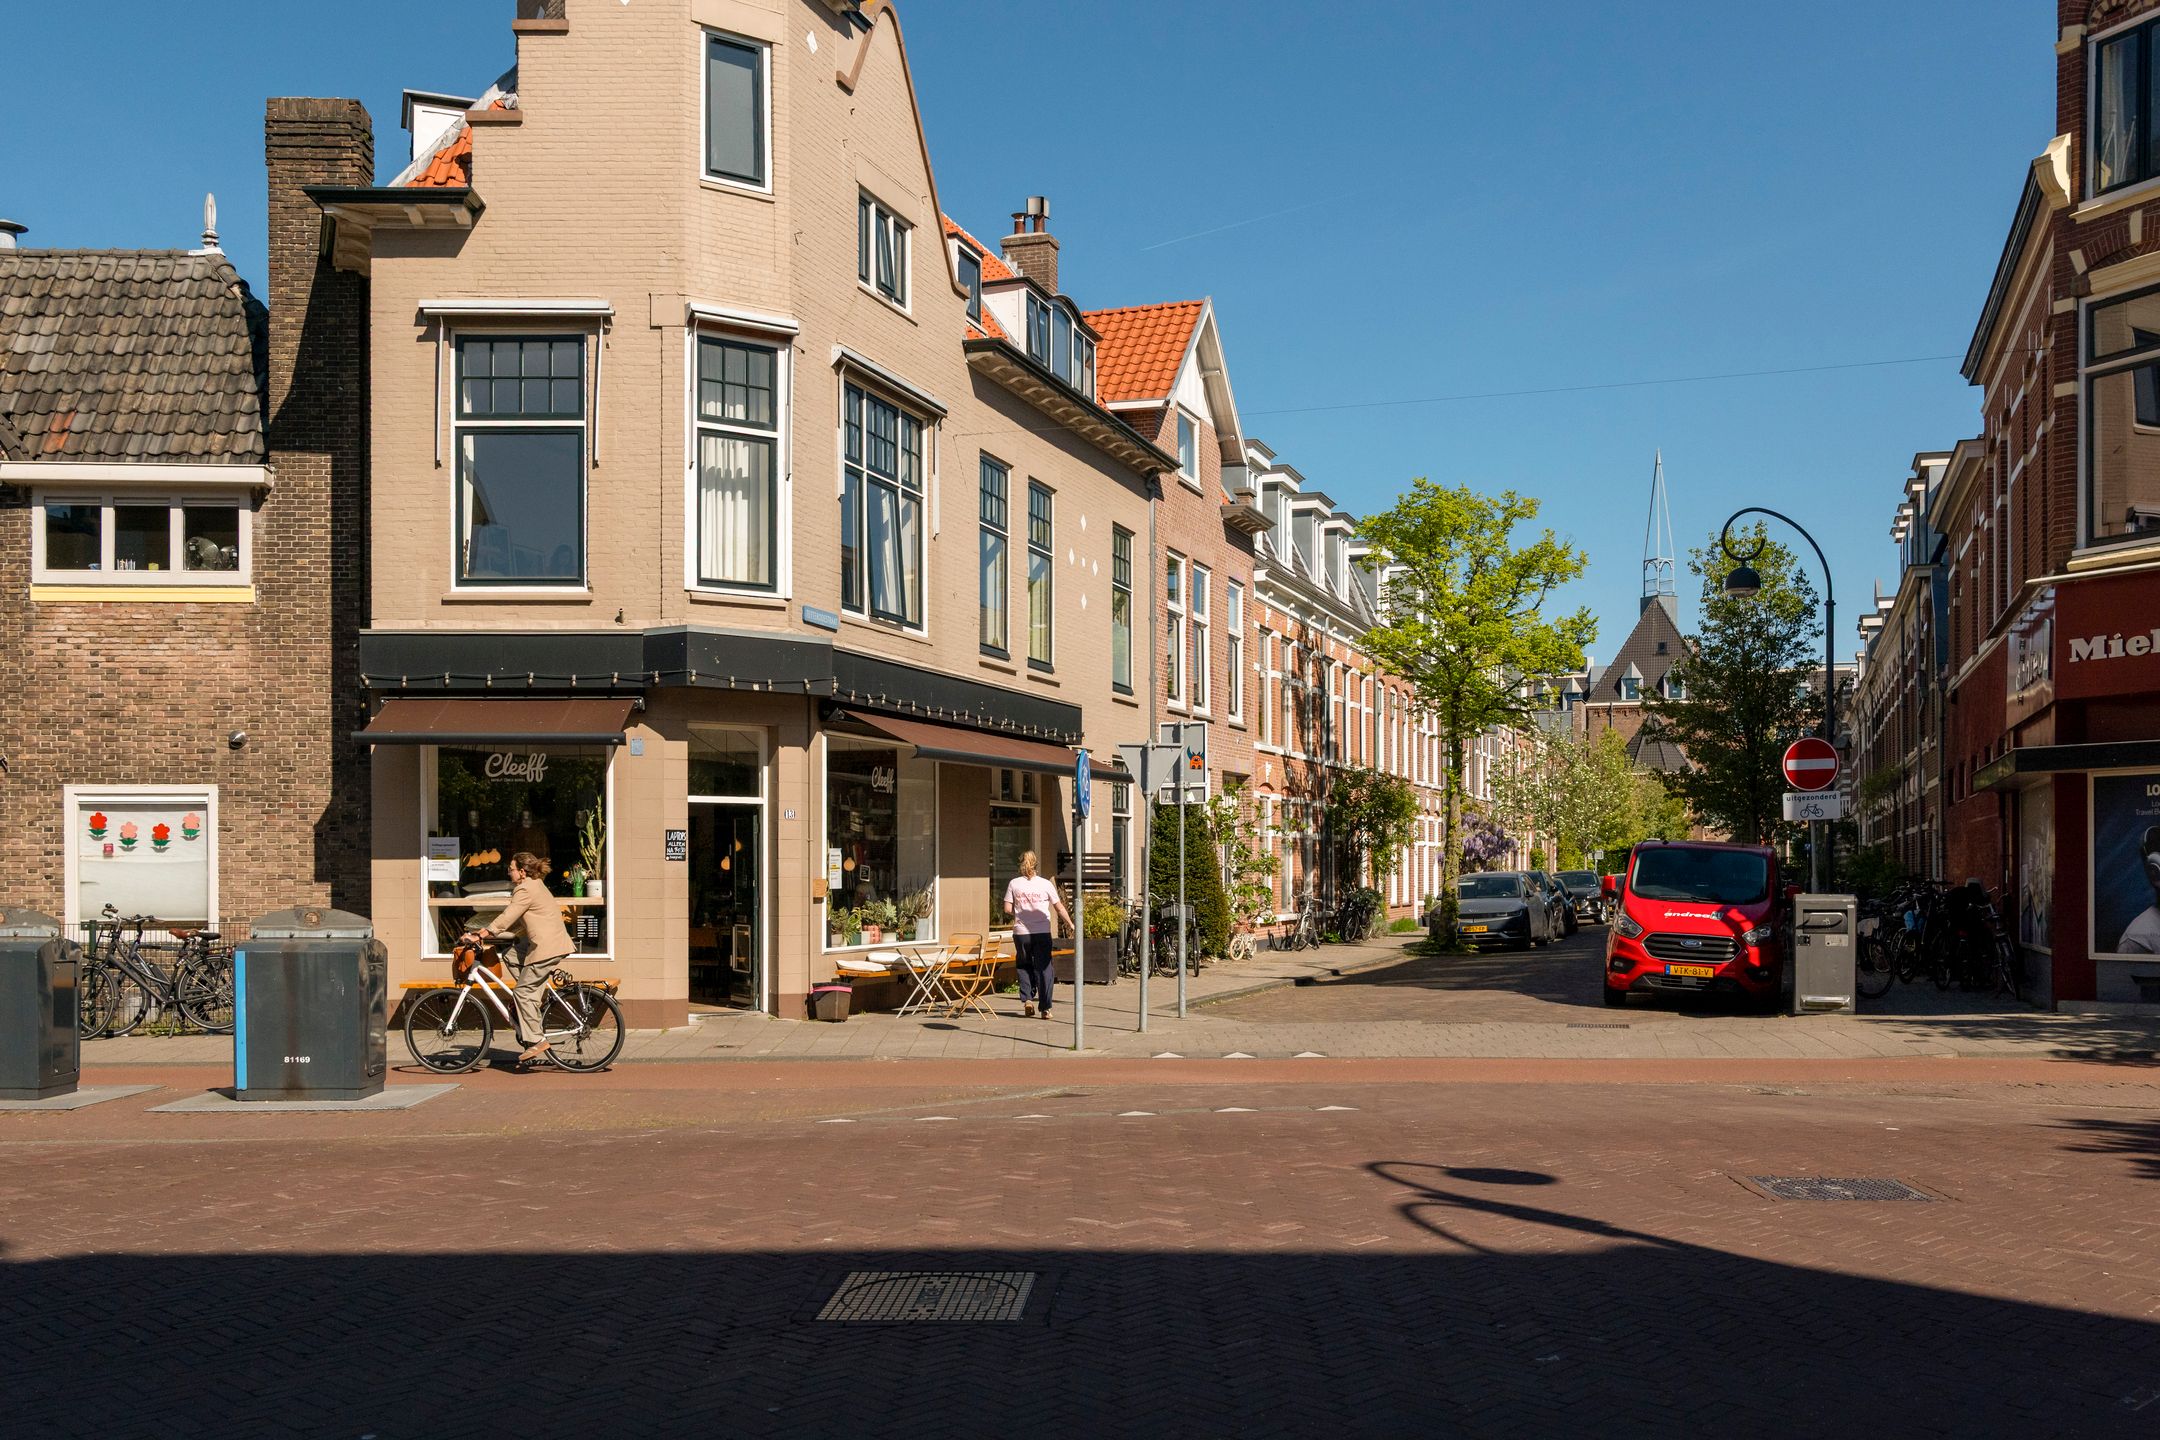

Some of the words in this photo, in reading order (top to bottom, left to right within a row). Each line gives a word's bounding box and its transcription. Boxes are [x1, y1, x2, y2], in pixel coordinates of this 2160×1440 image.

[484, 751, 549, 783] Cleeff
[1786, 793, 1837, 802] uitgezonderd
[785, 809, 795, 819] 13
